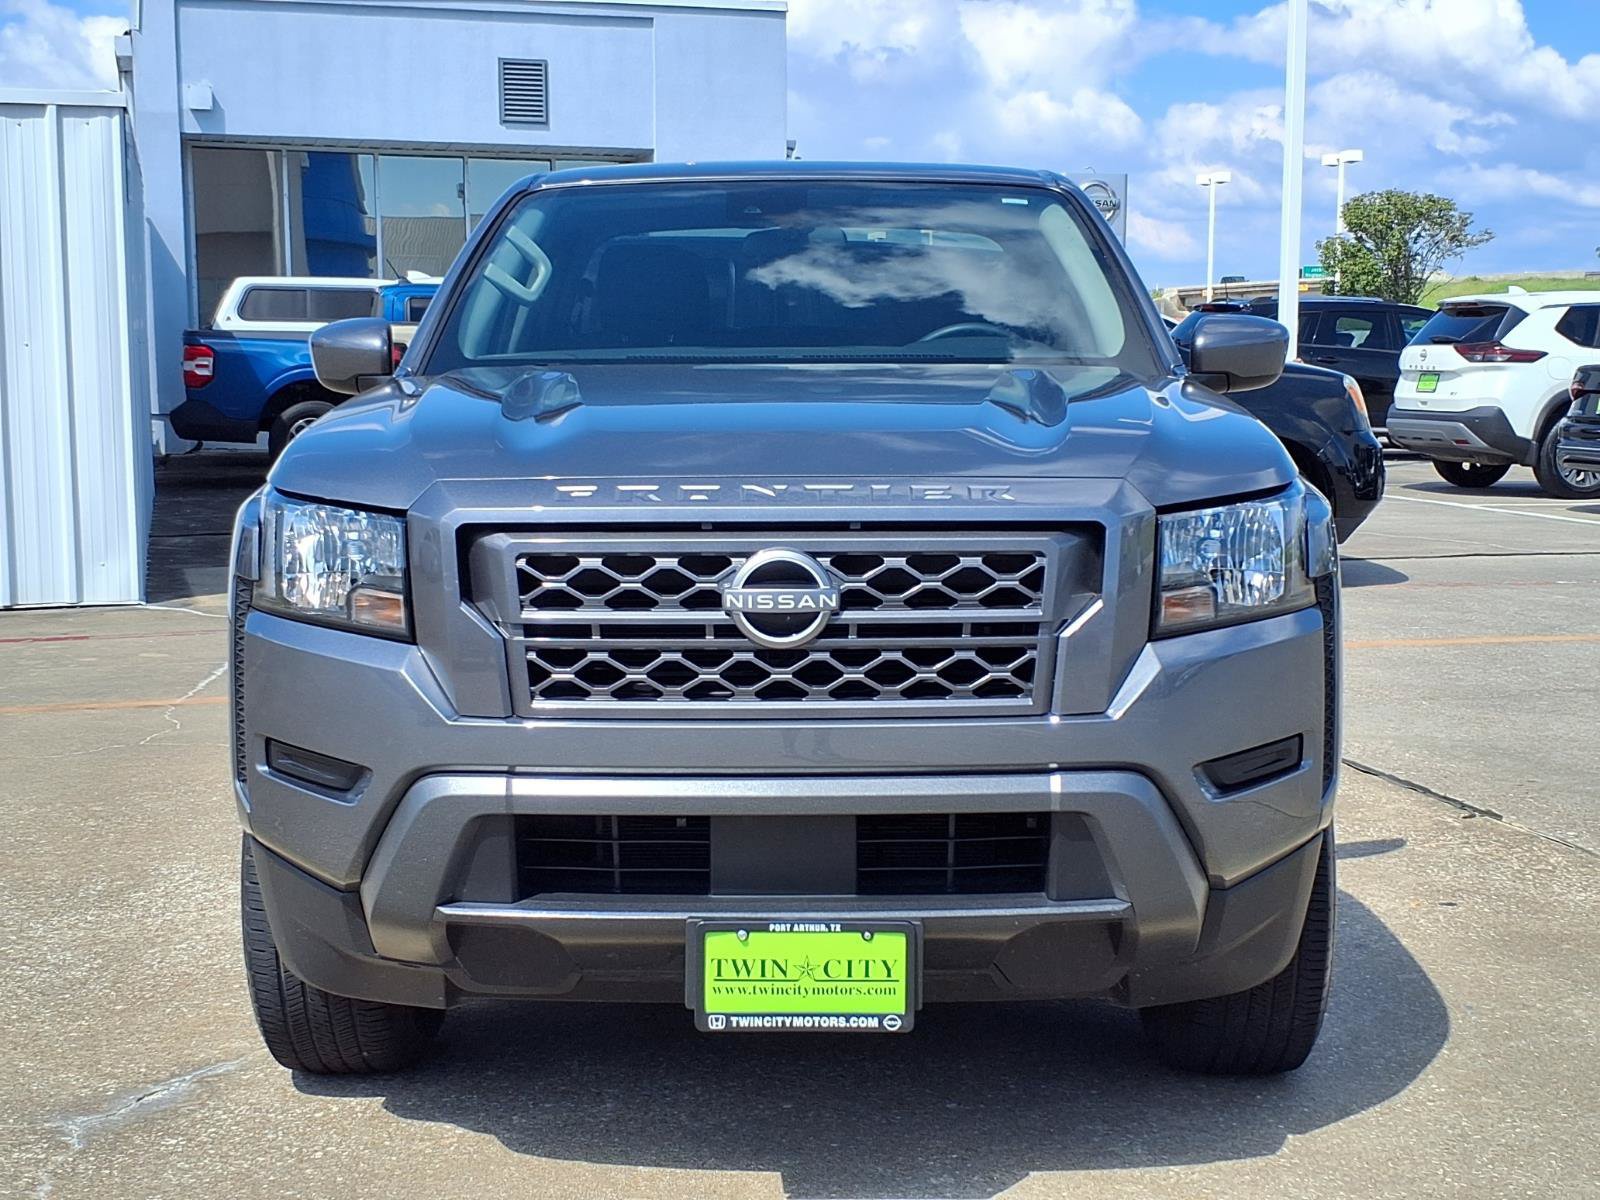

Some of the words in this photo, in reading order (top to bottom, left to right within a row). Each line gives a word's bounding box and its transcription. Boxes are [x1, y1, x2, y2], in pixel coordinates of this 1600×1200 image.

[553, 484, 1015, 502] FRONTIER
[726, 594, 837, 609] NISSAN
[769, 923, 791, 932] PORT
[830, 923, 842, 932] TX
[711, 958, 788, 979] TWIN
[823, 958, 898, 979] CITY
[712, 983, 897, 998] www.twincitymotors.com
[730, 1016, 879, 1029] TWINCITYMOTORS.COM
